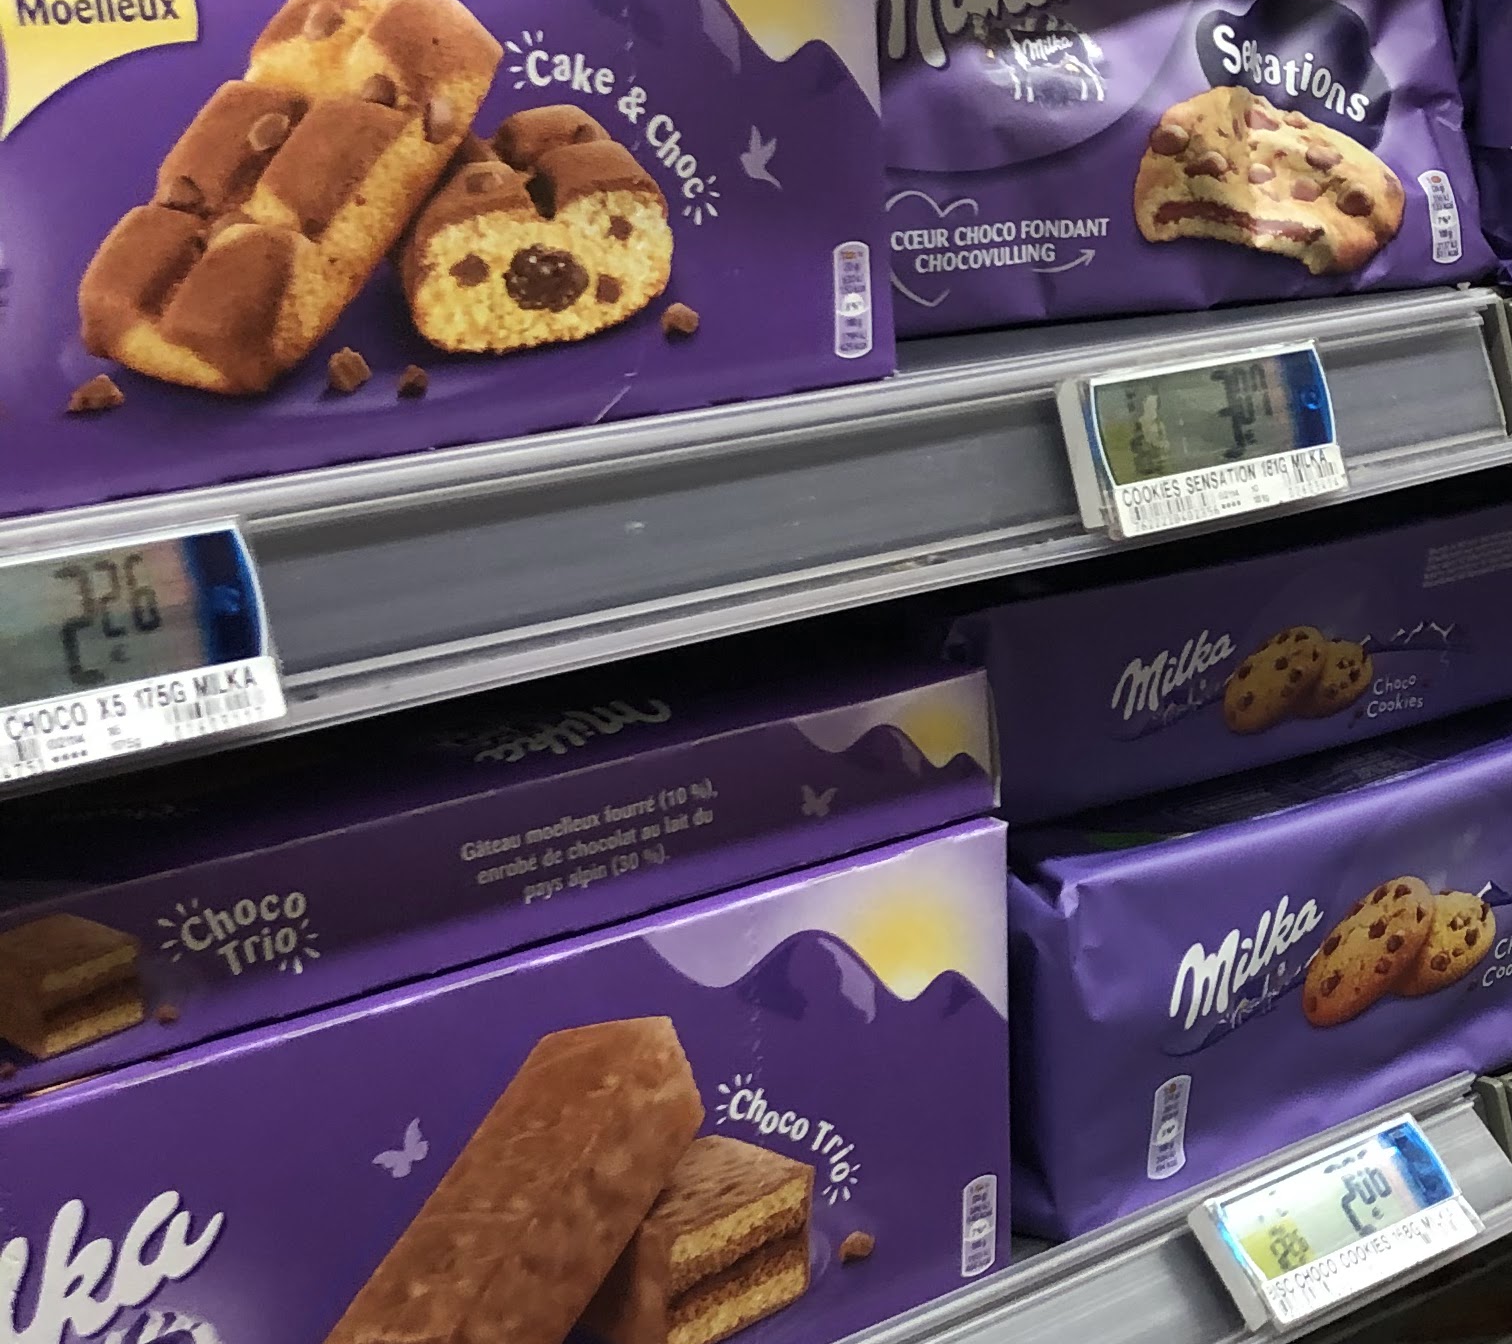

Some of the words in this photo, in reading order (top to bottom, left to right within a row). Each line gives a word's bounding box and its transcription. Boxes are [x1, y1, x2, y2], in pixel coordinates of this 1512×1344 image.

[525, 48, 614, 97] Cake
[616, 83, 648, 124] &
[644, 112, 706, 203] Choc
[914, 242, 1056, 275] CHOCOVULLING
[953, 222, 1017, 247] CHOCO
[1020, 216, 1110, 241] FONDANT
[1122, 479, 1181, 508] COOKIES
[1186, 464, 1257, 494] SENSATION
[1290, 449, 1328, 471] MILKA
[1110, 628, 1237, 721] Milka
[1371, 670, 1418, 696] Choco
[1366, 691, 1424, 719] Cookies
[460, 834, 522, 862] Gâteau
[476, 856, 538, 885] enrobé
[541, 847, 564, 867] de
[566, 828, 637, 861] chocolat
[640, 823, 661, 841] au
[663, 813, 689, 835] lait
[692, 807, 714, 827] du
[523, 876, 564, 905] pays
[180, 888, 308, 955] Choco
[220, 923, 300, 978] Trio
[1168, 893, 1326, 1033] Milka
[728, 1085, 809, 1142] Choco
[810, 1118, 852, 1182] Trio
